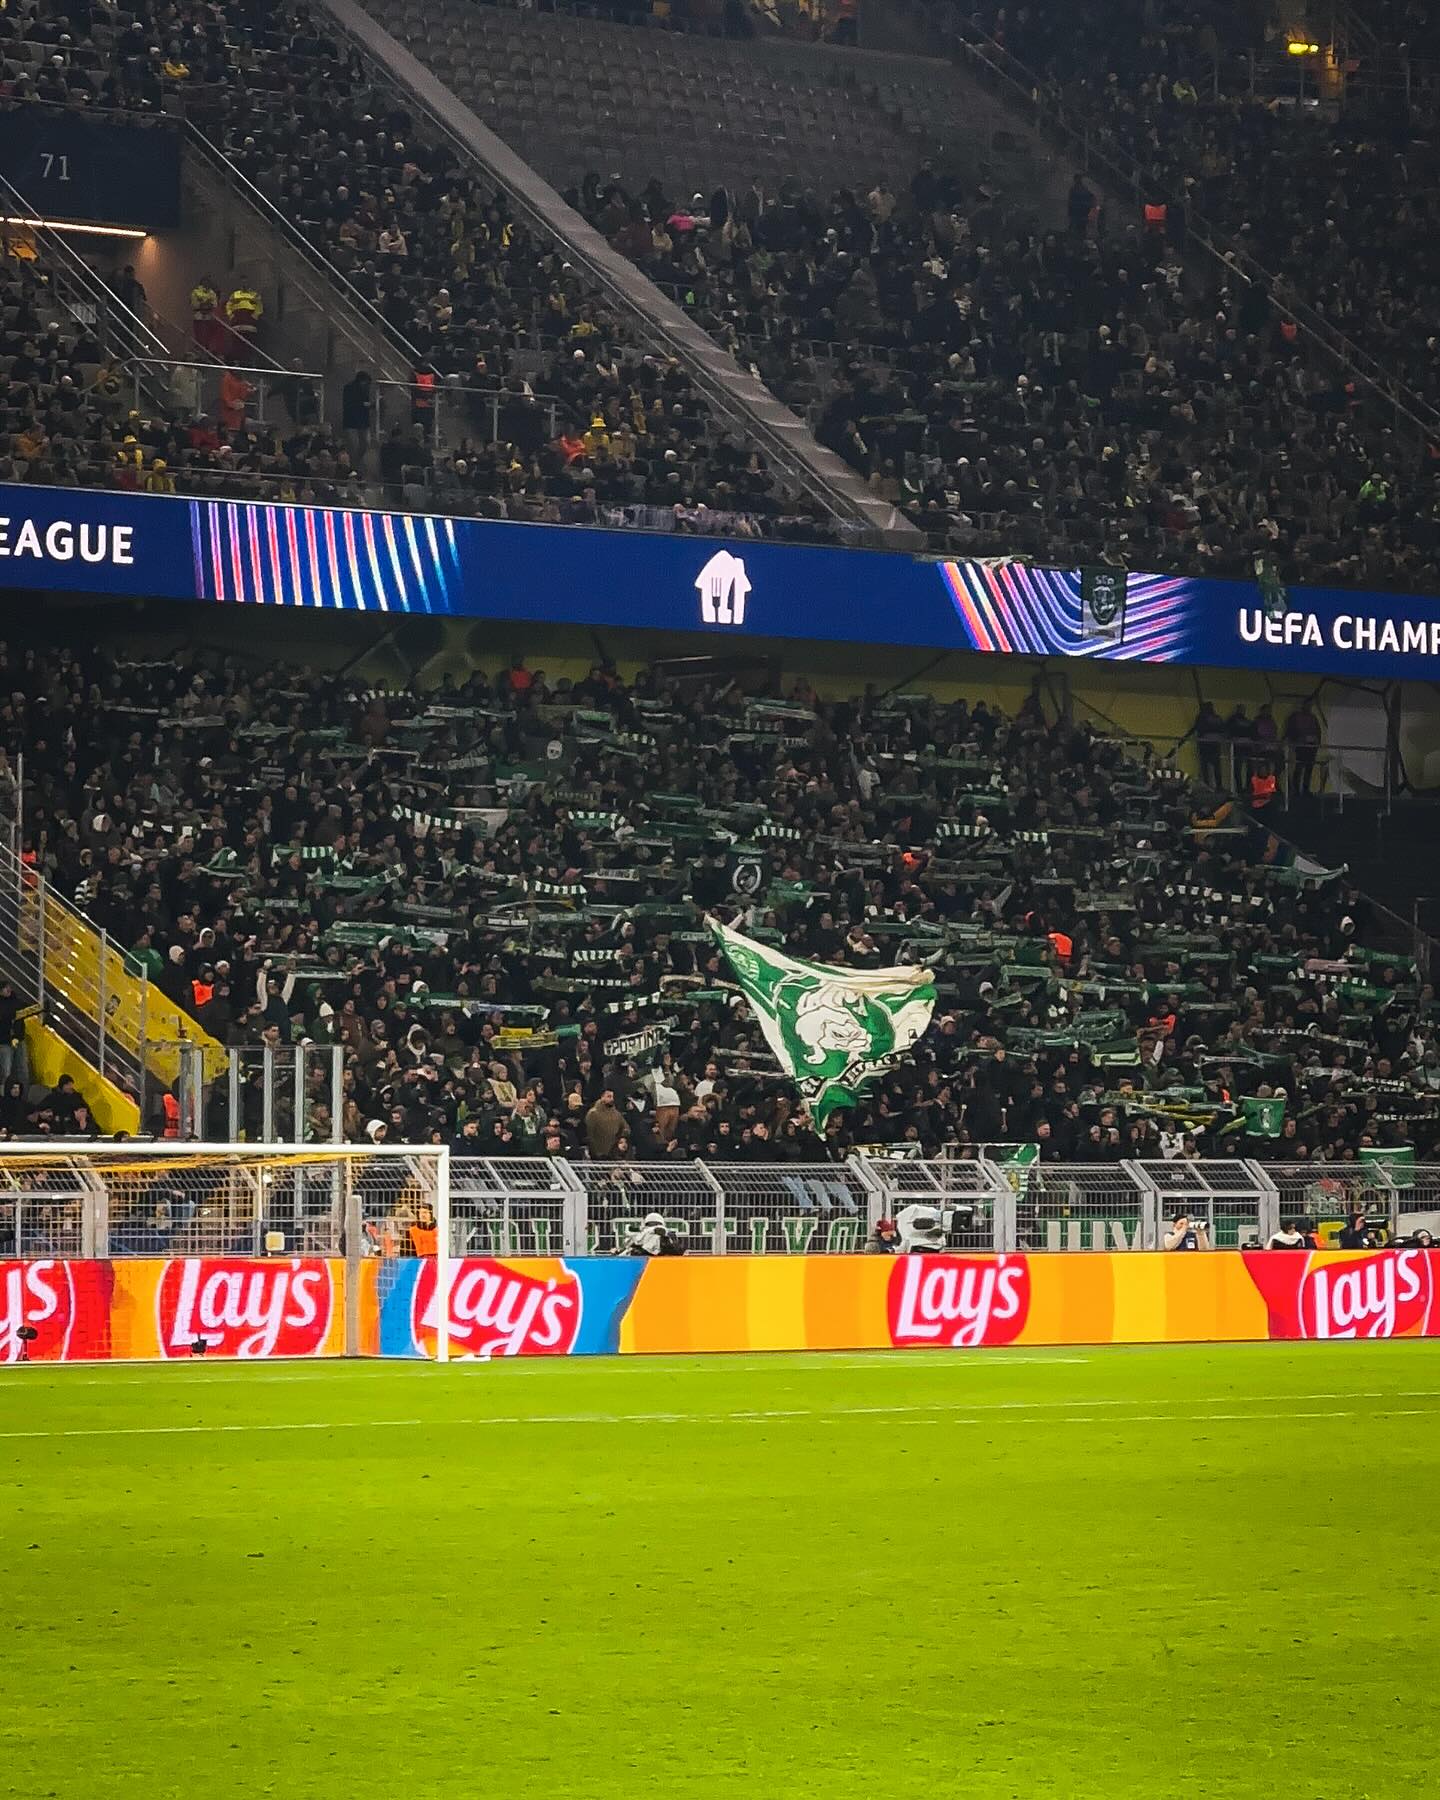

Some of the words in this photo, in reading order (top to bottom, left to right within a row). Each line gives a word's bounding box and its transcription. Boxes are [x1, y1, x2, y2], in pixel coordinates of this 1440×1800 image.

[40, 152, 71, 181] 71
[1239, 608, 1325, 646] UEFA
[170, 1258, 321, 1357] Lay's
[420, 1258, 573, 1356] Lay's
[896, 1253, 1024, 1347] Lay's
